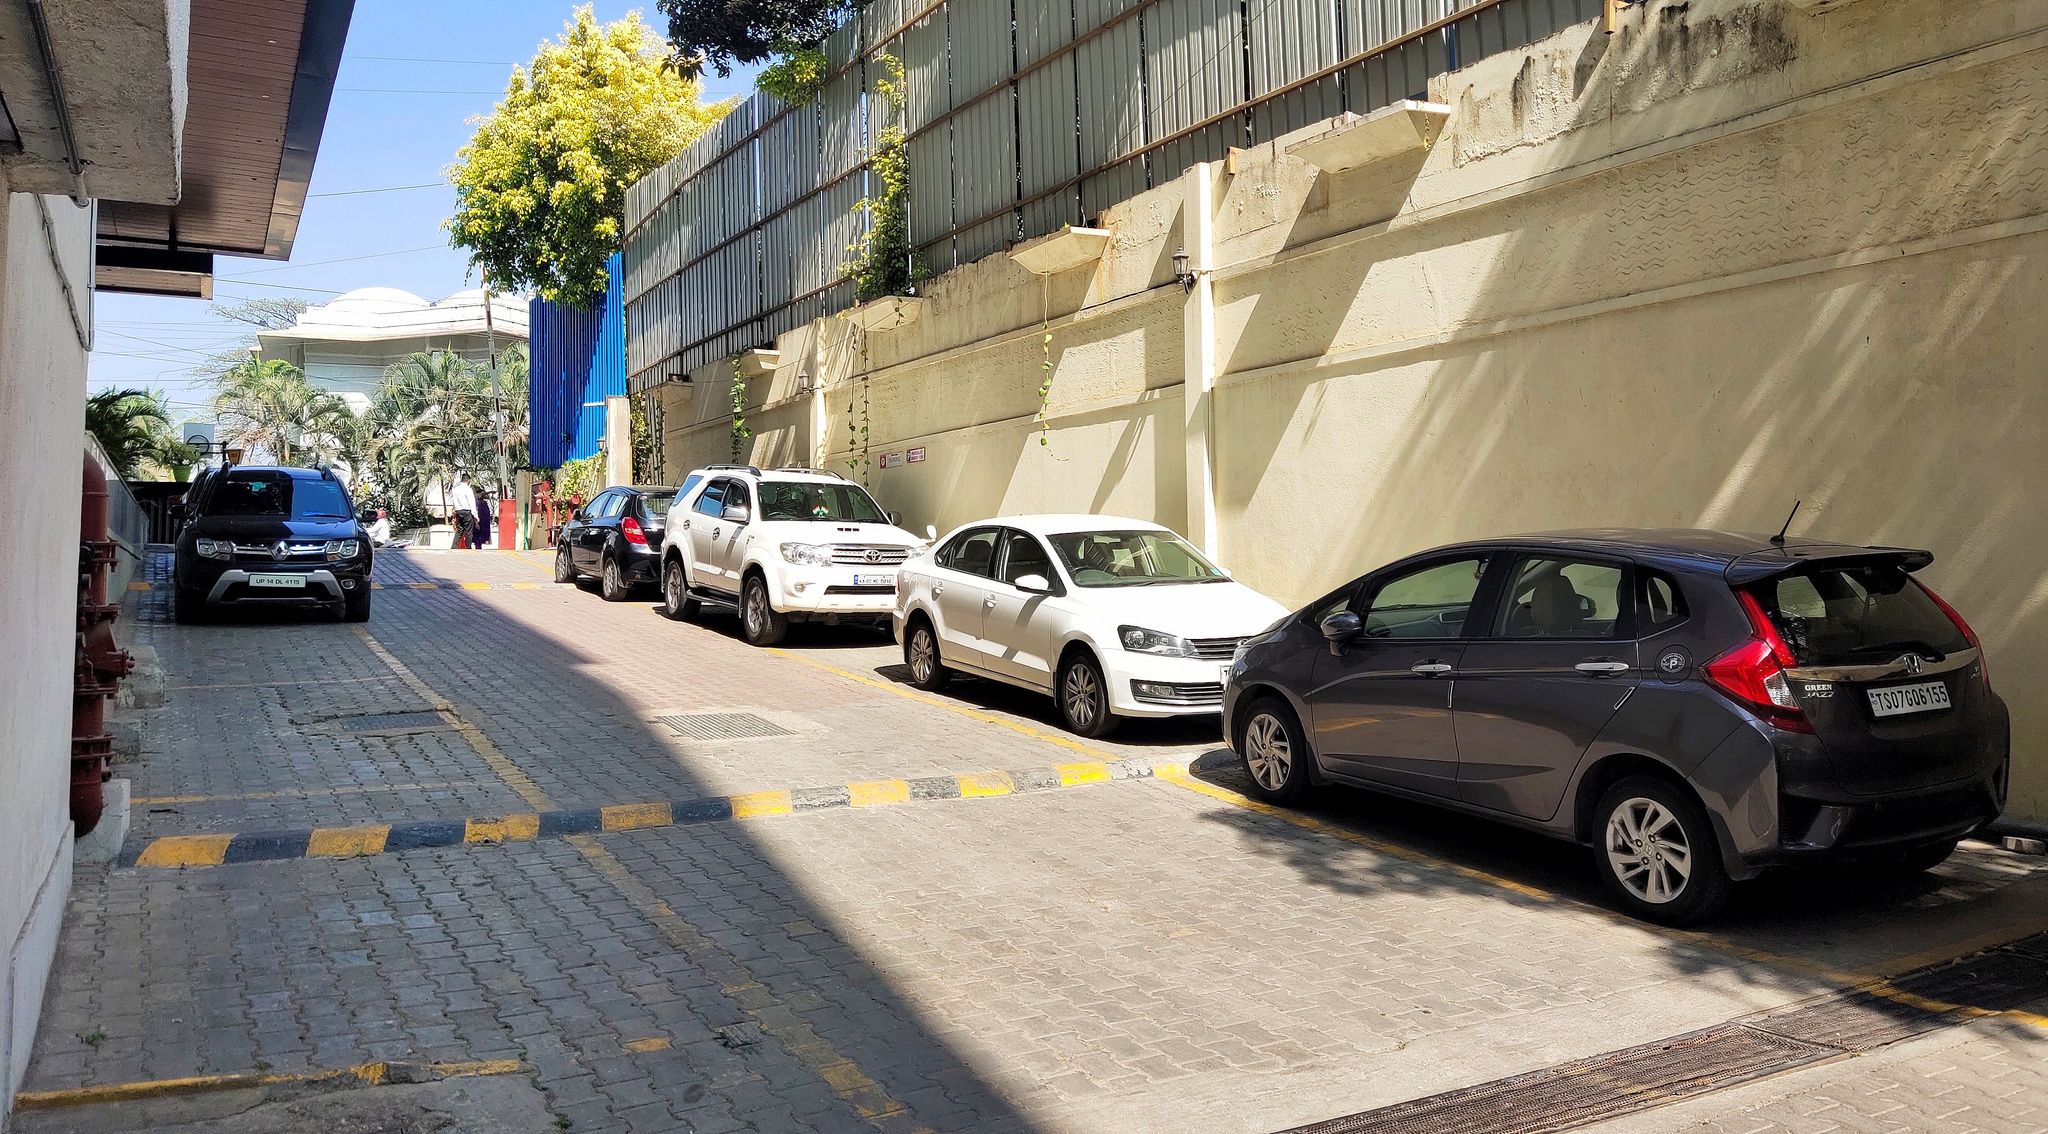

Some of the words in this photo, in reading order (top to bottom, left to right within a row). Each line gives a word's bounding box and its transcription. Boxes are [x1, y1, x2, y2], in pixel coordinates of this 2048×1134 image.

[1669, 658, 1678, 669] P
[1804, 684, 1833, 692] GREEN
[1802, 691, 1834, 699] JAZZ
